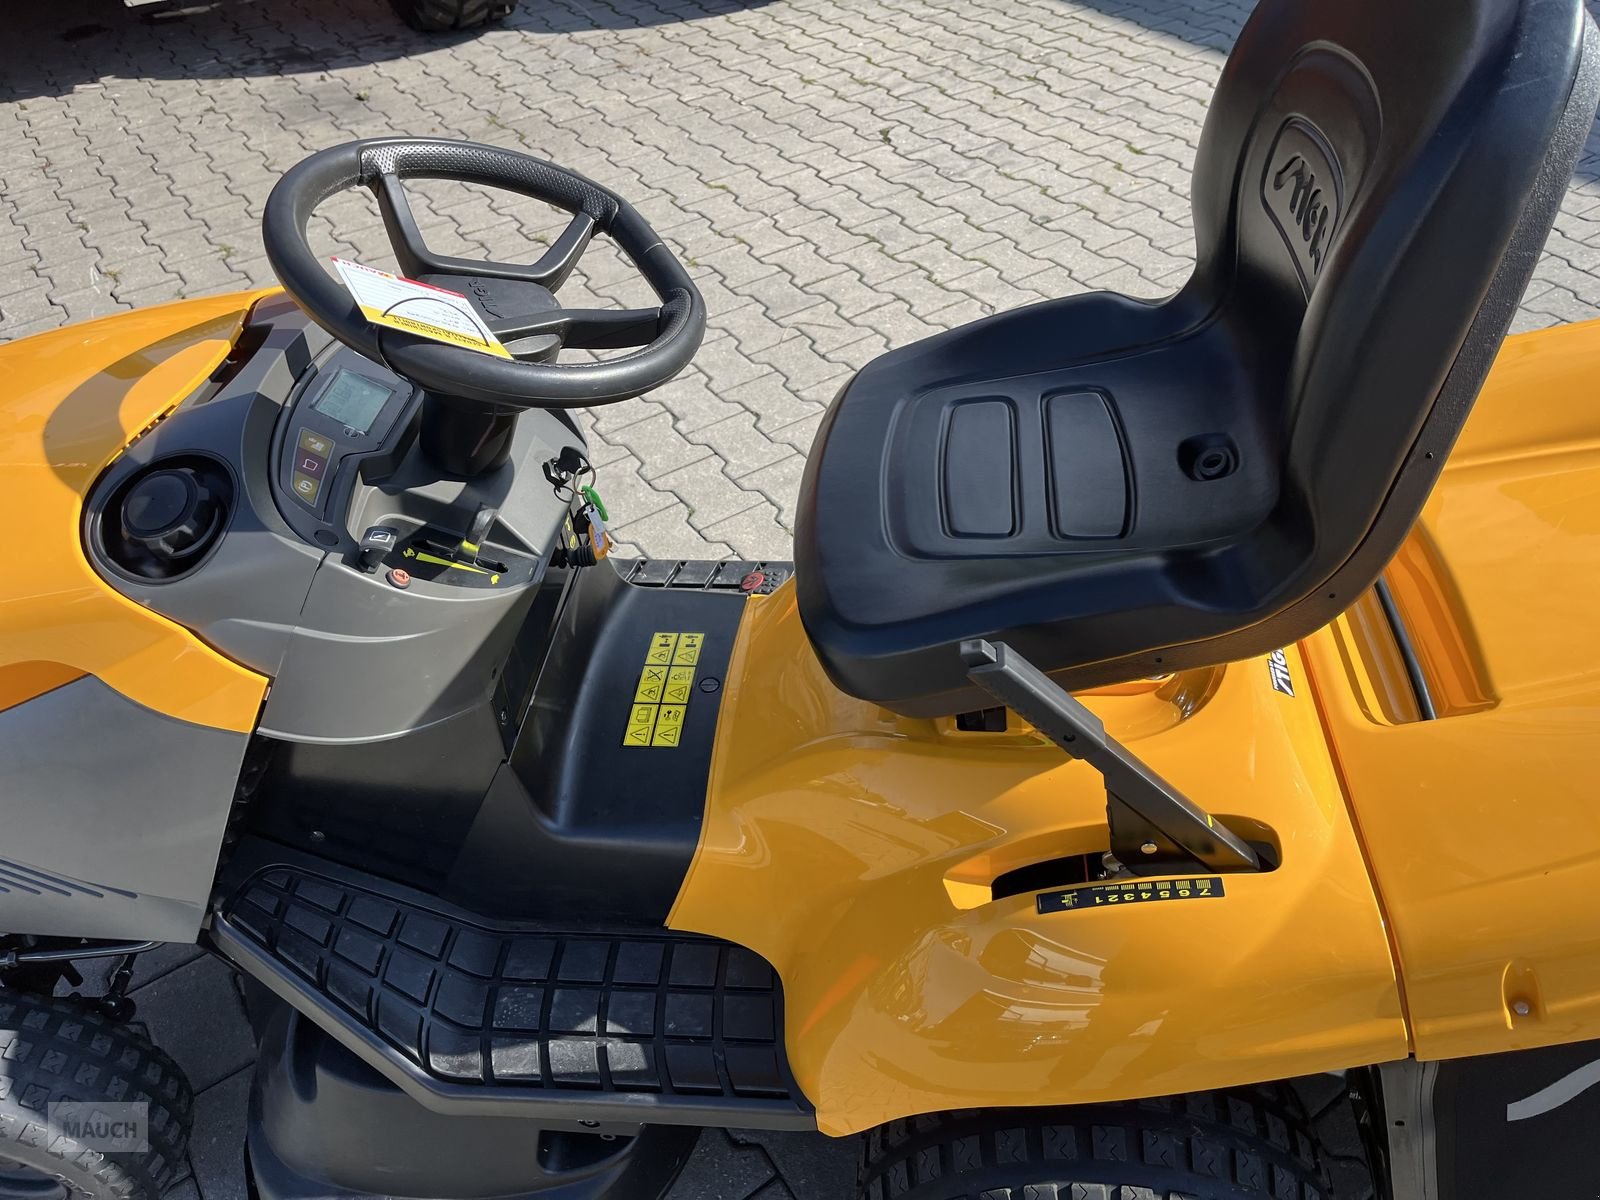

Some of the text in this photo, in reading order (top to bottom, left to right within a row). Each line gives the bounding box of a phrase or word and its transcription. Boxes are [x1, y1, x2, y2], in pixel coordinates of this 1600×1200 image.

[1271, 648, 1294, 697] STIG
[1141, 892, 1152, 900] 4
[1159, 890, 1170, 898] 5
[1200, 888, 1211, 896] 7
[1095, 896, 1103, 904] 1
[1108, 894, 1119, 902] 2
